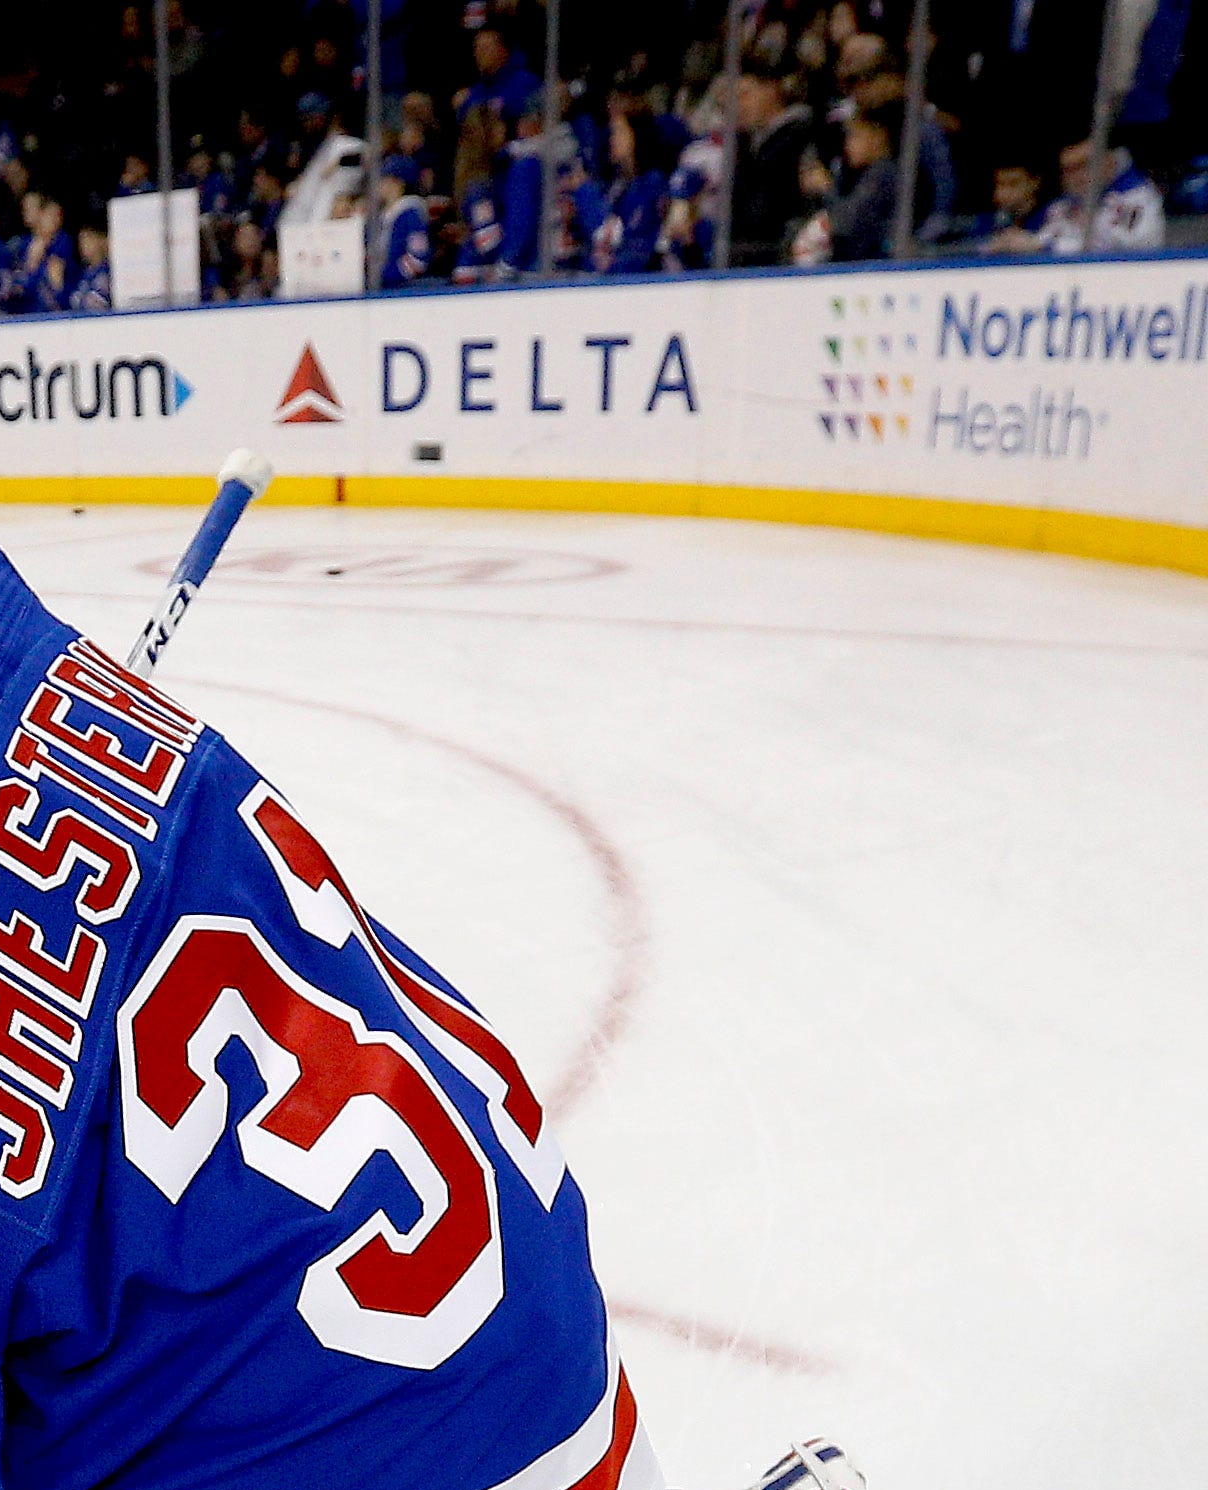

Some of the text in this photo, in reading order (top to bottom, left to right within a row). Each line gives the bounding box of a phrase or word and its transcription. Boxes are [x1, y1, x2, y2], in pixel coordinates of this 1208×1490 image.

[382, 333, 698, 412] DELTA
[928, 386, 1091, 458] Health
[116, 780, 568, 1371] 31
